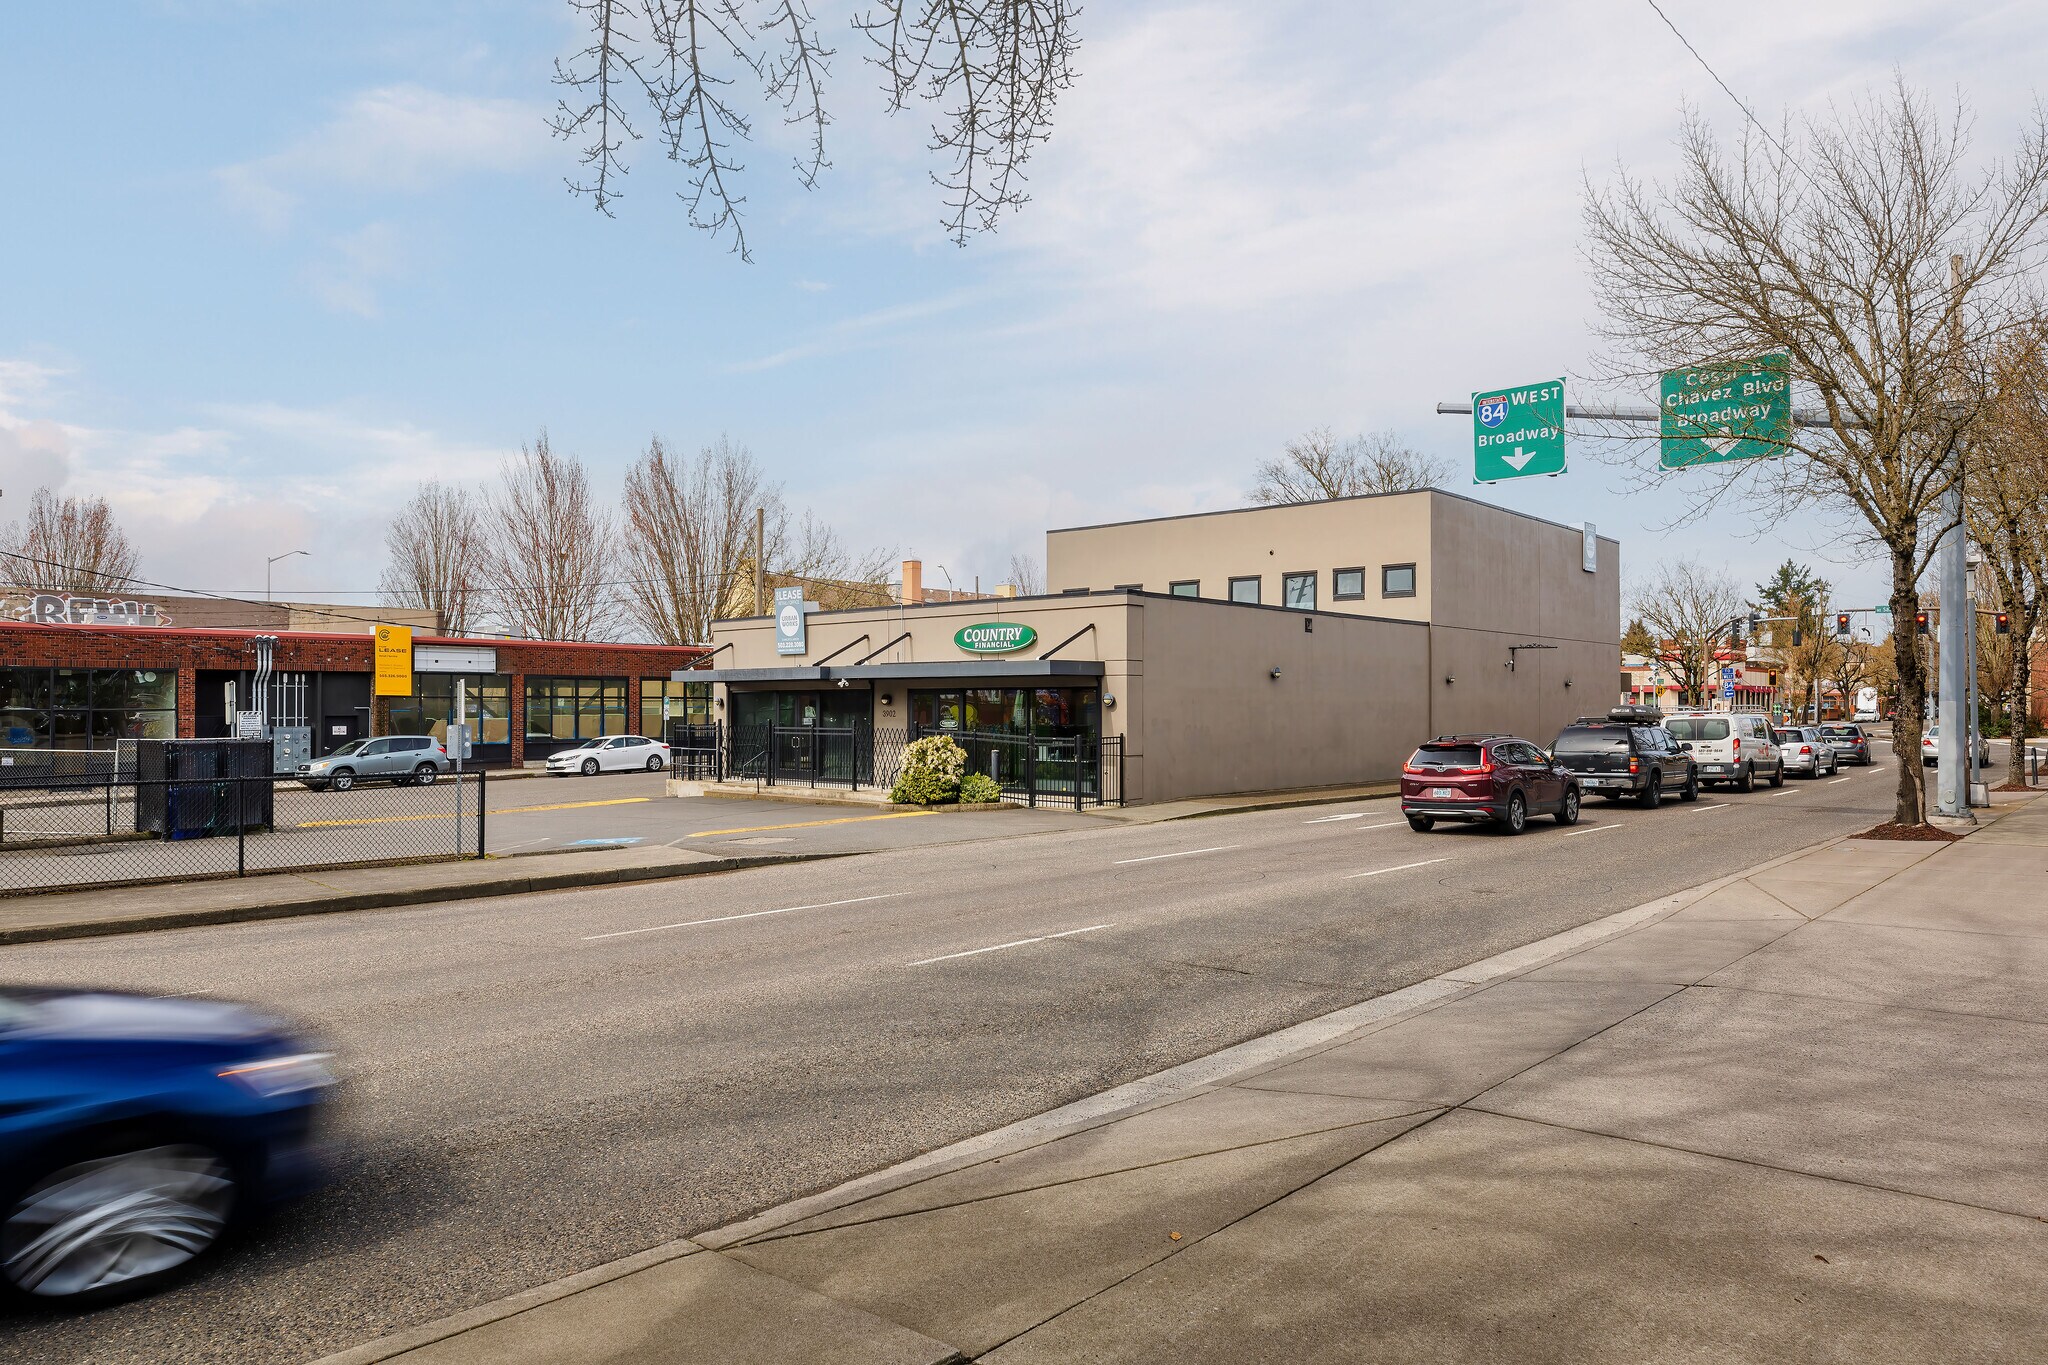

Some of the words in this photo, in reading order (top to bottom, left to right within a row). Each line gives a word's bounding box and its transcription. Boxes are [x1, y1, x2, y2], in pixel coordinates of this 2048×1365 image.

[1511, 386, 1560, 406] WEST
[1743, 378, 1784, 397] Blvd
[1481, 403, 1505, 423] 84
[1677, 403, 1771, 427] Broadway
[1478, 427, 1559, 447] Broadway
[780, 590, 802, 600] LEASE
[964, 628, 1022, 642] COUNTRY
[882, 710, 897, 718] 3902
